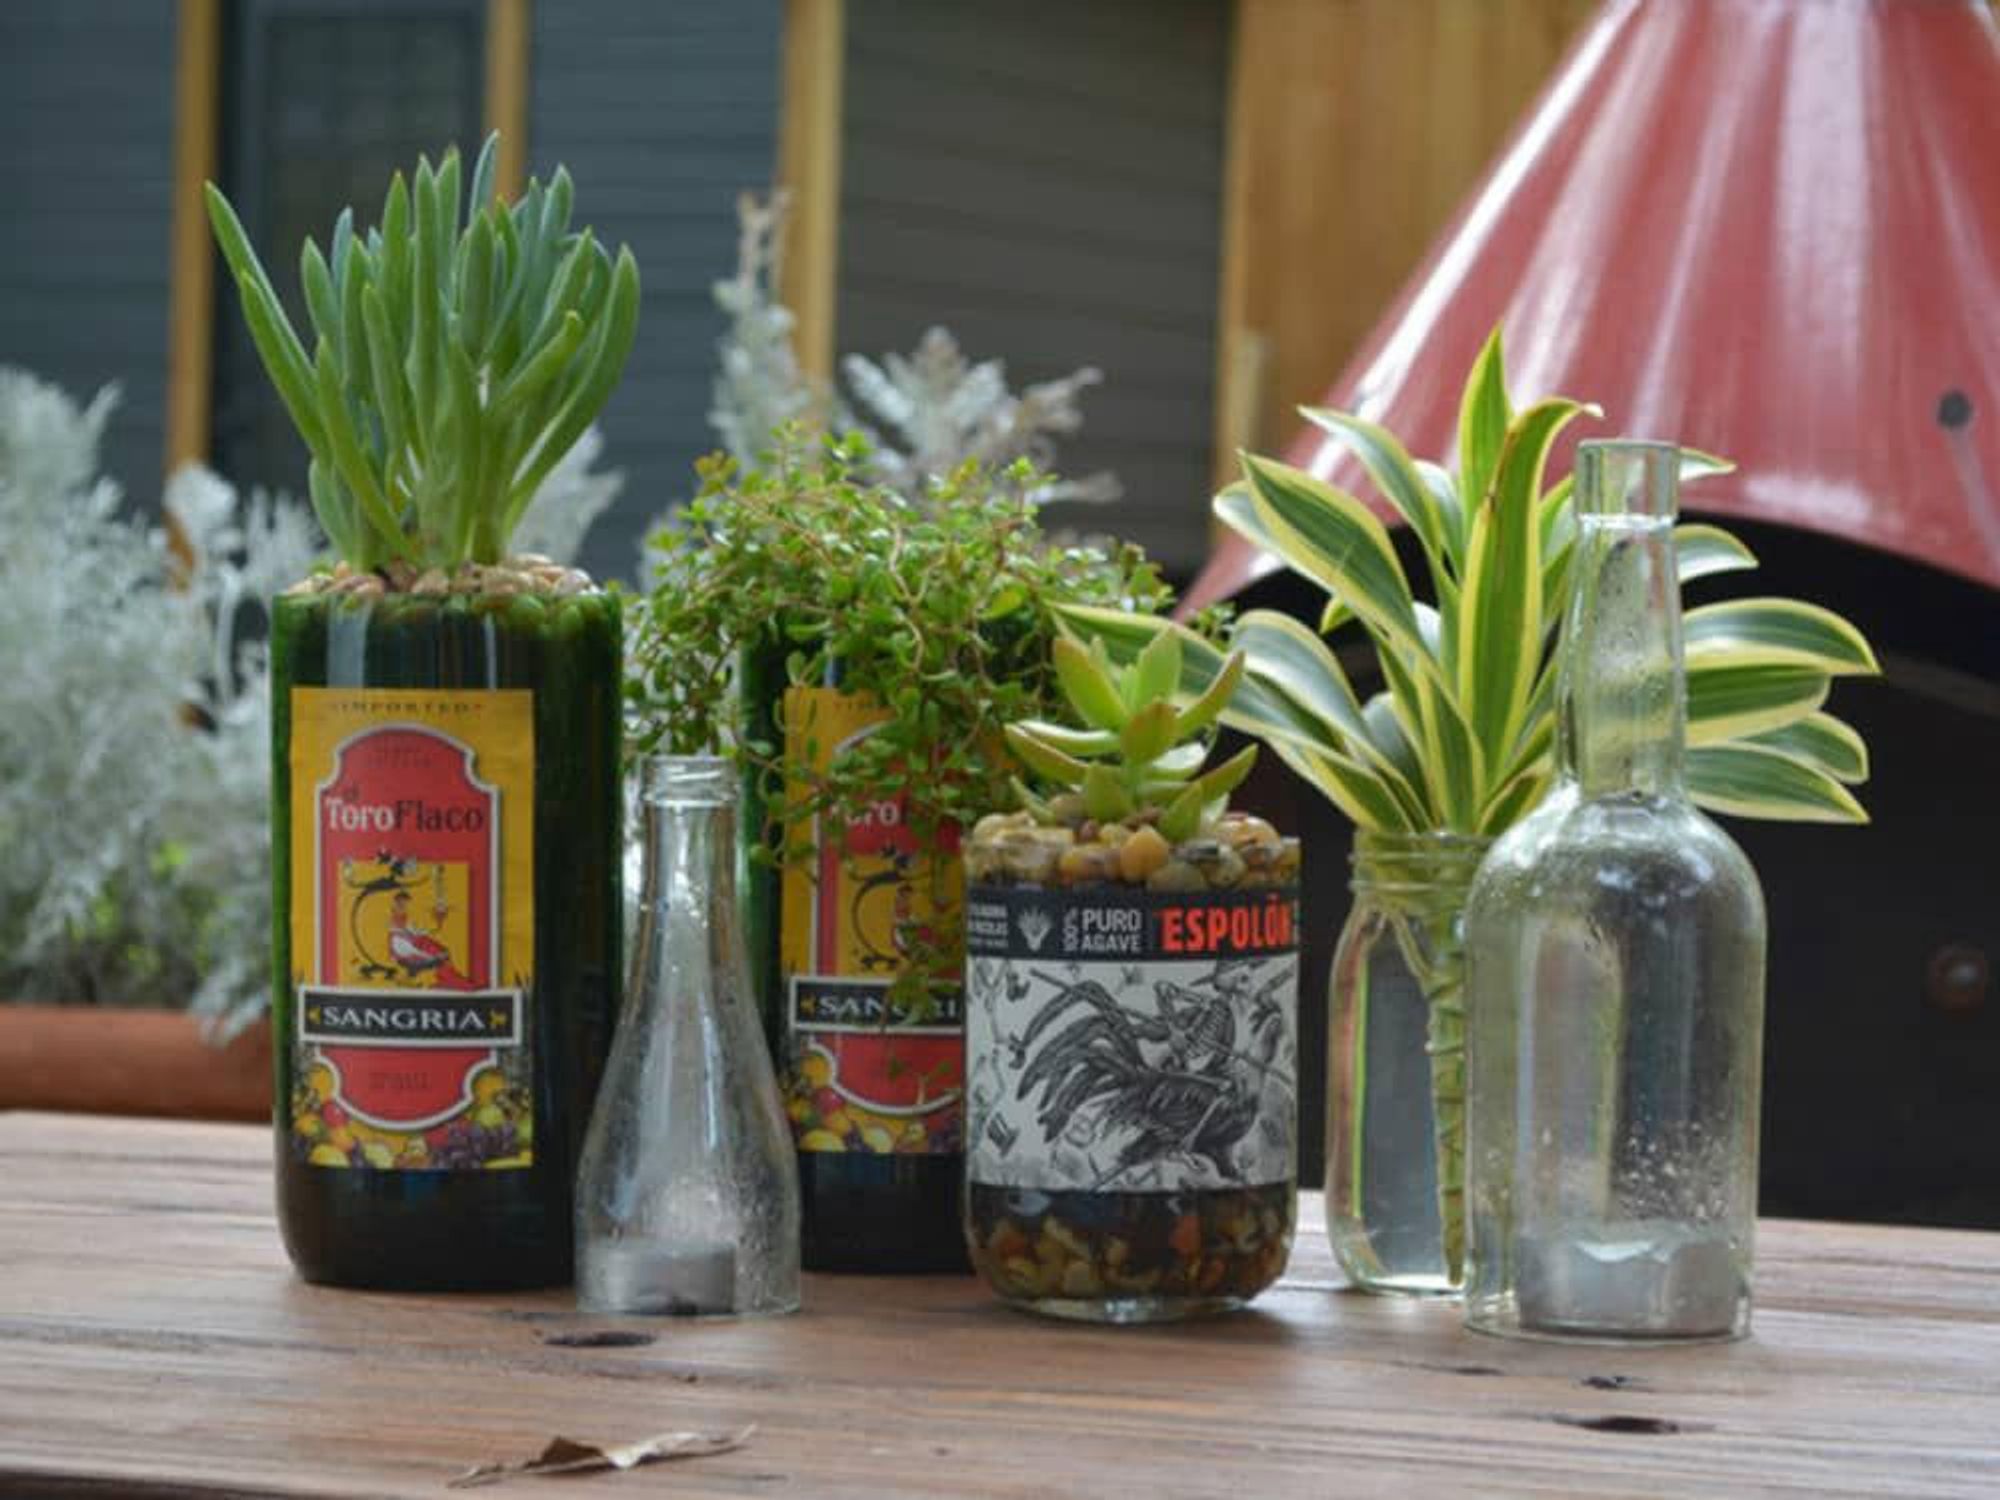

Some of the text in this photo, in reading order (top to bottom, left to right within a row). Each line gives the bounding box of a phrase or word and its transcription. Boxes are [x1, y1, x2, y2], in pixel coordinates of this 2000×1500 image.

[1082, 908, 1142, 932] PURO
[1080, 934, 1142, 952] AGAVE
[323, 1005, 485, 1030] SANGRIA
